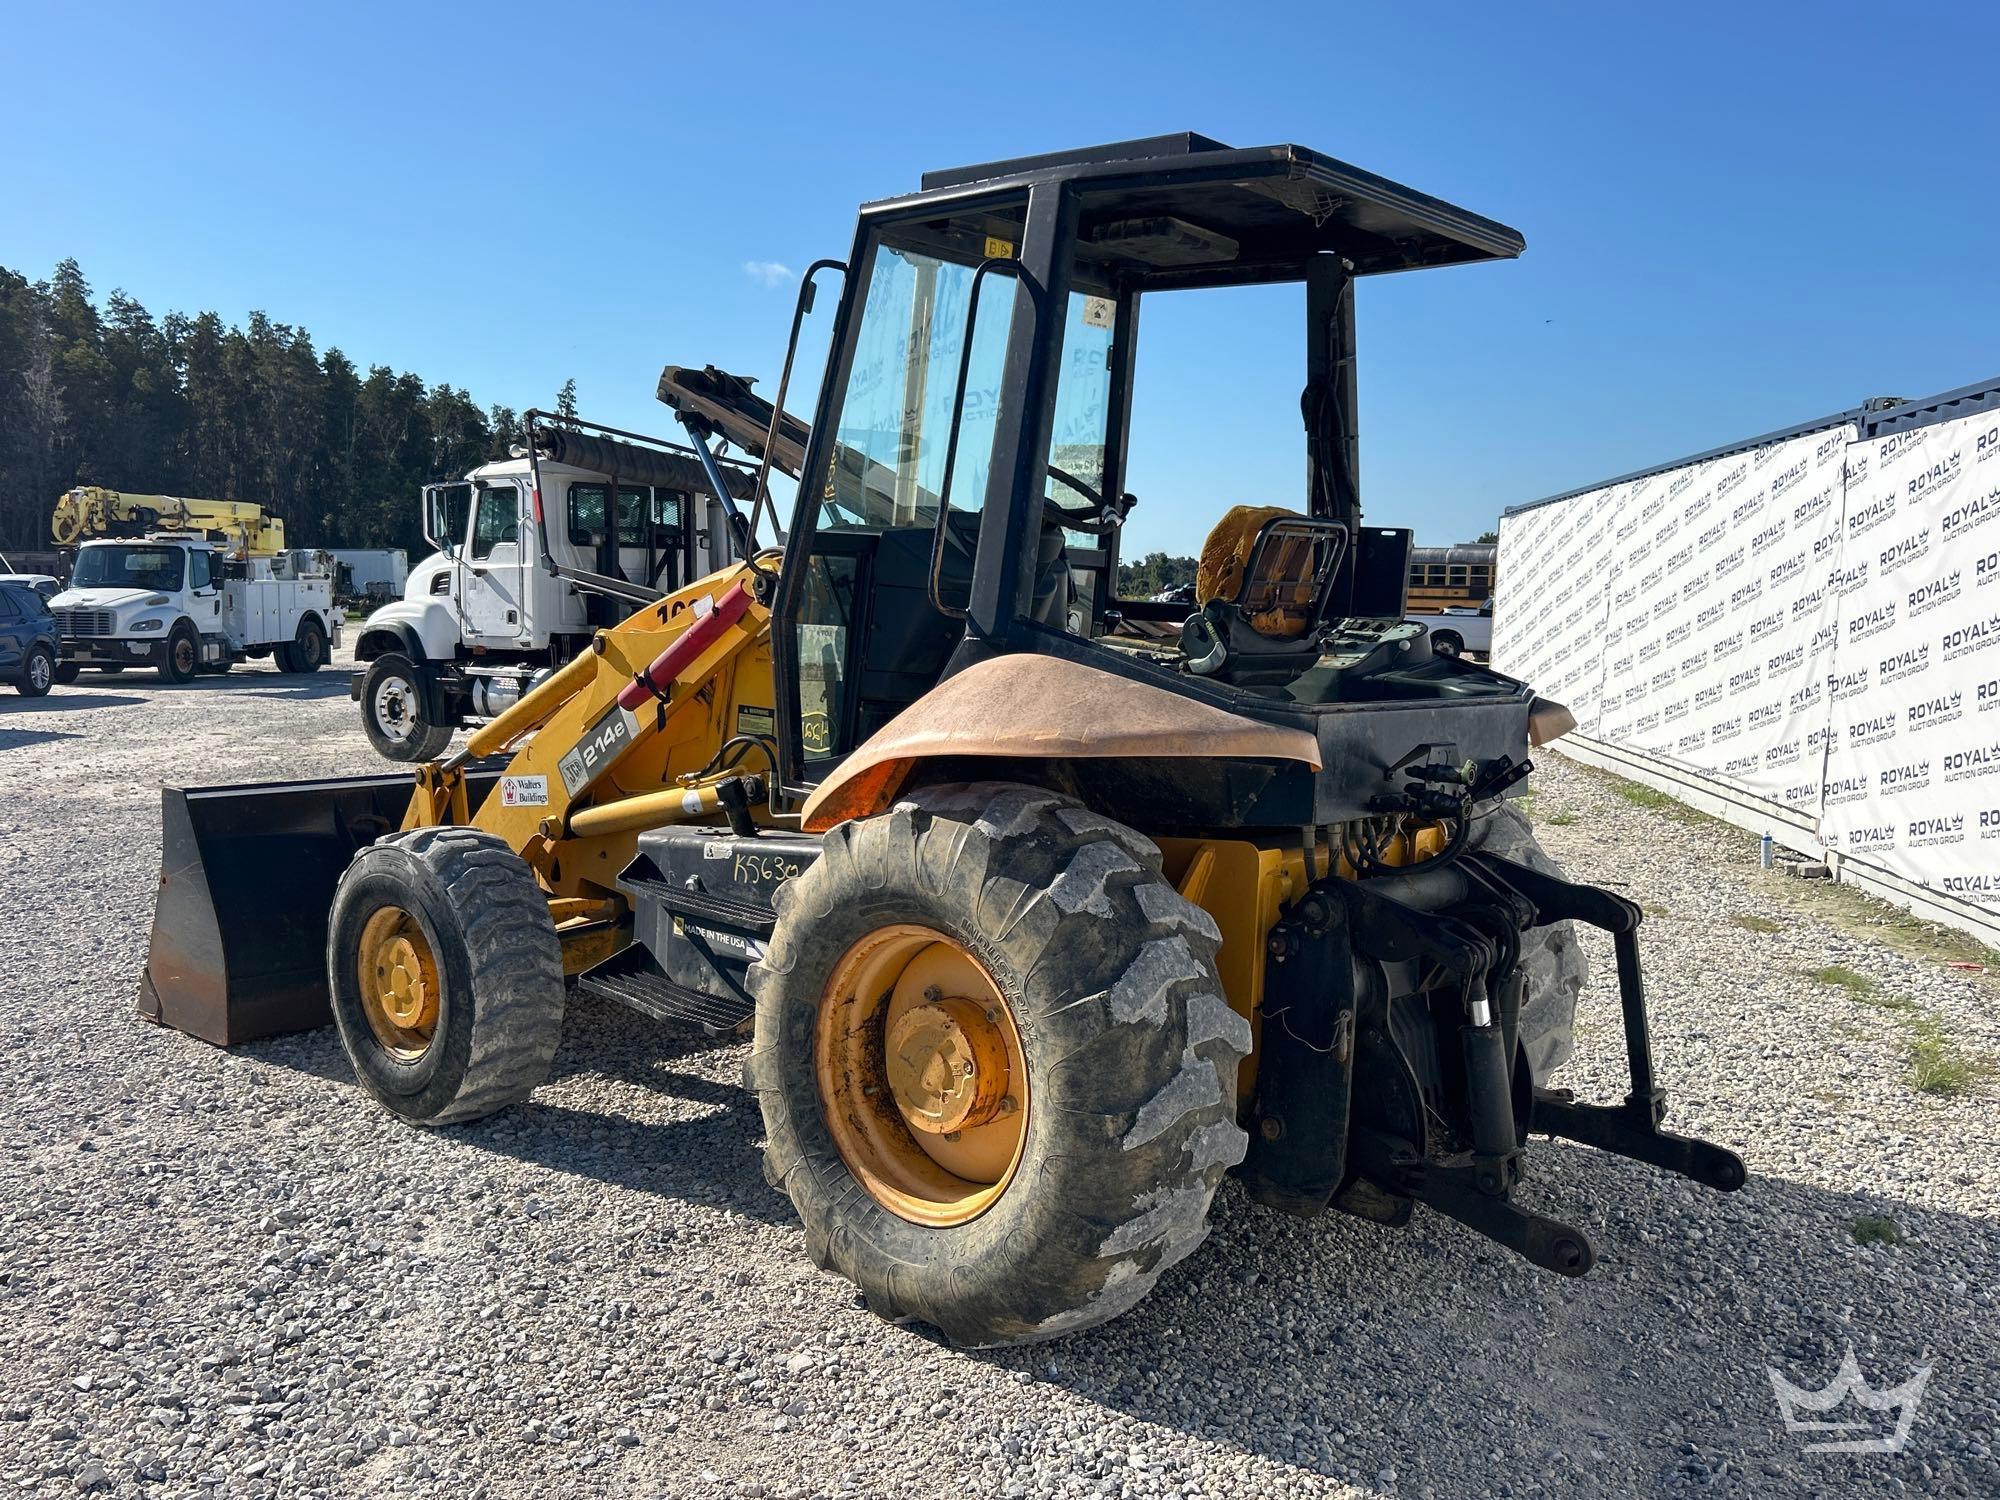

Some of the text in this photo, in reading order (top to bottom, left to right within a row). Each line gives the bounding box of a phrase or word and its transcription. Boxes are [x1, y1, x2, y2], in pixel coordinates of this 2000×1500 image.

[1880, 448, 1906, 469] AUCTION
[1717, 468, 1739, 493] ROYAL
[1772, 464, 1799, 492] ROYAL
[1909, 459, 1949, 495] ROYAL
[1909, 468, 1960, 505] AUCTION GROUP
[1733, 496, 1757, 521] ROYAL
[1794, 493, 1823, 521] ROYAL
[1849, 499, 1885, 530] ROYAL
[1942, 496, 1987, 532] ROYAL
[1850, 508, 1895, 540] AUCTION GROUP
[1942, 522, 1973, 543] AUCTION
[1752, 524, 1777, 549] ROYAL
[1880, 535, 1917, 566] ROYAL
[1880, 545, 1929, 576] AUCTION GROUP
[1716, 551, 1737, 573] ROYAL
[1771, 556, 1797, 581] ROYAL
[1977, 551, 2000, 575] RO
[1731, 582, 1755, 604] ROYAL
[1849, 578, 1868, 593] GROUP
[1909, 577, 1948, 607] ROYAL
[1793, 589, 1821, 614] ROYAL
[1909, 588, 1960, 618] AUCTION GROUP
[1751, 613, 1776, 635] ROYAL
[1850, 607, 1885, 634] ROYAL
[1850, 629, 1874, 643] AUCTION
[1875, 618, 1895, 633] GROUP
[1714, 634, 1736, 654] ROYAL
[1943, 621, 1988, 650] ROYAL
[1769, 649, 1795, 670] ROYAL
[1880, 649, 1917, 675] ROYAL
[1943, 645, 1974, 661] AUCTION
[1730, 668, 1753, 688] ROYAL
[1880, 661, 1929, 685] AUCTION GROUP
[1849, 684, 1868, 697] GROUP
[1978, 679, 2000, 700] RO
[1749, 704, 1774, 722] ROYAL
[1909, 696, 1949, 721] ROYAL
[1712, 719, 1734, 736] ROYAL
[1850, 717, 1885, 738] ROYAL
[1909, 710, 1961, 732] AUCTION GROUP
[584, 722, 624, 768] 214e
[1875, 730, 1896, 741] GROUP
[1766, 742, 1793, 761] ROYAL
[1944, 747, 1990, 771] ROYAL
[566, 762, 582, 784] JCB
[1726, 756, 1751, 771] ROYAL
[1881, 764, 1918, 785] ROYAL
[1944, 763, 2000, 782] AUCTION GROU
[518, 780, 541, 789] Walters
[1786, 784, 1814, 800] ROYAL
[1824, 778, 1858, 796] ROYAL
[1881, 779, 1929, 795] AUCTION GROUP
[520, 793, 548, 804] Buildings
[1848, 792, 1868, 801] GROUP
[1849, 827, 1885, 843] ROYAL
[1909, 817, 1951, 836] ROYAL
[1910, 834, 1963, 847] AUCTION GROUP
[684, 924, 745, 949] MADE IN THE USA
